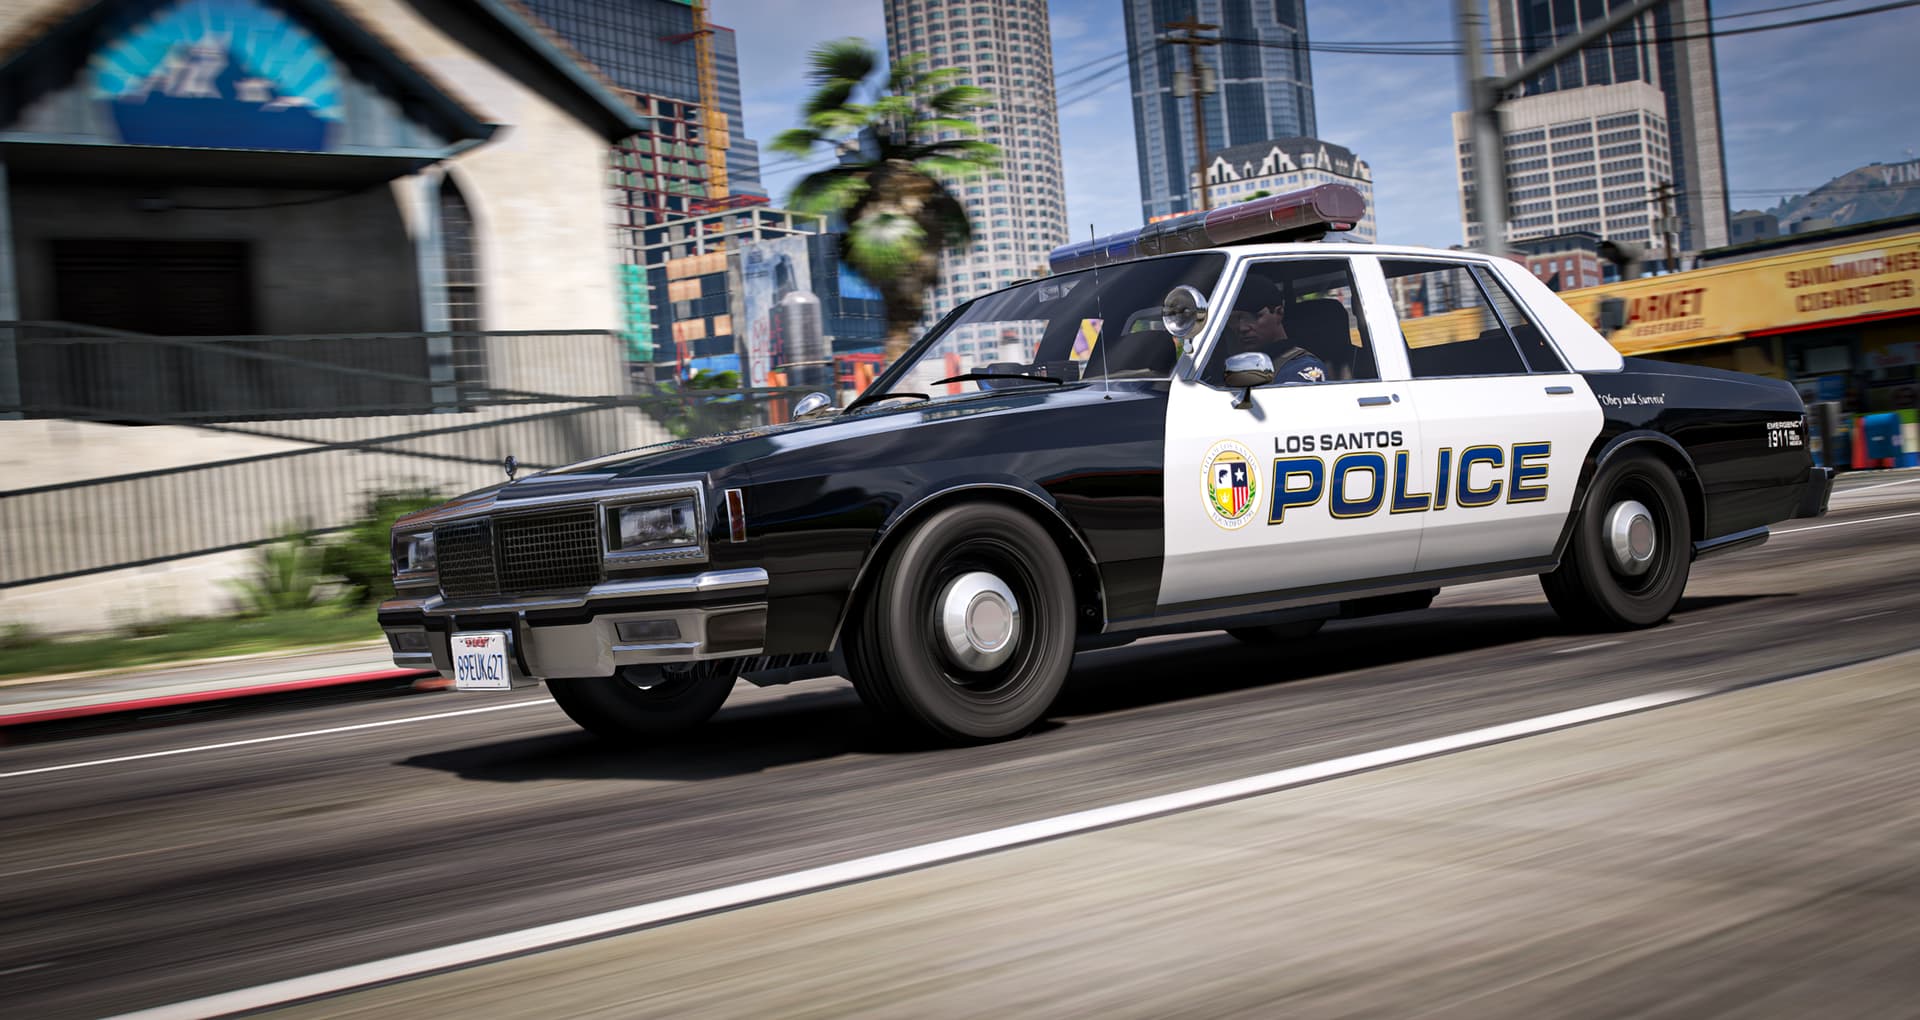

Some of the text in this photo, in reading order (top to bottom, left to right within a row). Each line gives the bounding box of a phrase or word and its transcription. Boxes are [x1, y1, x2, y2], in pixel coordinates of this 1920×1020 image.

[1785, 252, 1920, 288] SANDWICHES
[1600, 287, 1706, 328] ARKET
[1795, 279, 1914, 313] CIGARETTES
[1623, 393, 1637, 405] and
[1767, 420, 1802, 429] EMERGENCY
[1274, 431, 1403, 454] LOS SANTOS
[1772, 429, 1789, 448] 911
[1268, 441, 1552, 525] POLICE
[458, 654, 503, 681] 89EUK627
